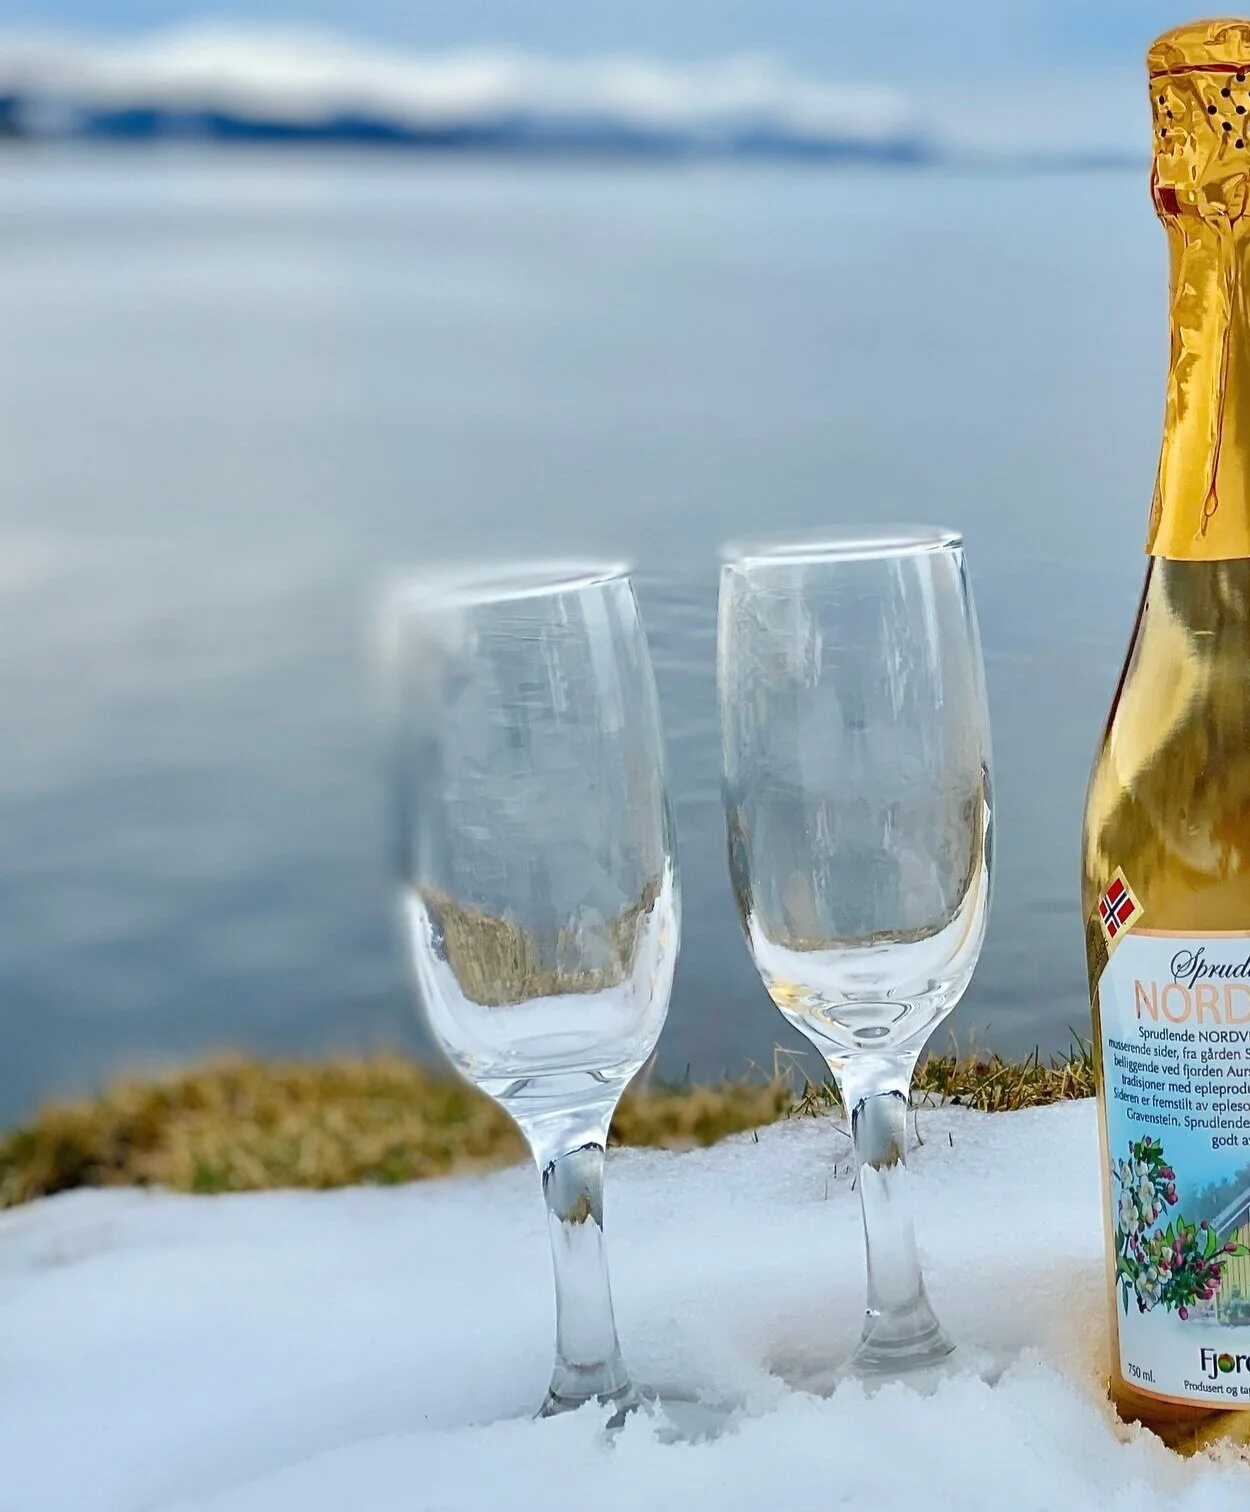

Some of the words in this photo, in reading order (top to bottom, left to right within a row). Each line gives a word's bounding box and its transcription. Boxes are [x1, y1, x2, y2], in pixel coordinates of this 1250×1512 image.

[1138, 1026, 1195, 1042] Sprudlende
[1108, 1038, 1150, 1055] musserende
[1154, 1045, 1179, 1060] sider,
[1183, 1048, 1197, 1059] fra
[1201, 1048, 1241, 1063] gården
[1162, 1064, 1180, 1075] ved
[1183, 1064, 1223, 1079] fjorden
[1122, 1074, 1165, 1091] tradisjoner
[1168, 1082, 1191, 1093] med
[1114, 1087, 1139, 1104] Sideren
[1142, 1096, 1150, 1105] er
[1153, 1095, 1192, 1111] fremstilt
[1196, 1102, 1208, 1111] av
[1127, 1108, 1181, 1127] Gravenstein.
[1184, 1116, 1250, 1130] Sprudlende
[1212, 1134, 1239, 1149] godt
[1128, 1363, 1140, 1378] 750
[1142, 1370, 1156, 1383] ml.
[1184, 1380, 1223, 1394] Produsert
[1227, 1386, 1238, 1397] og
